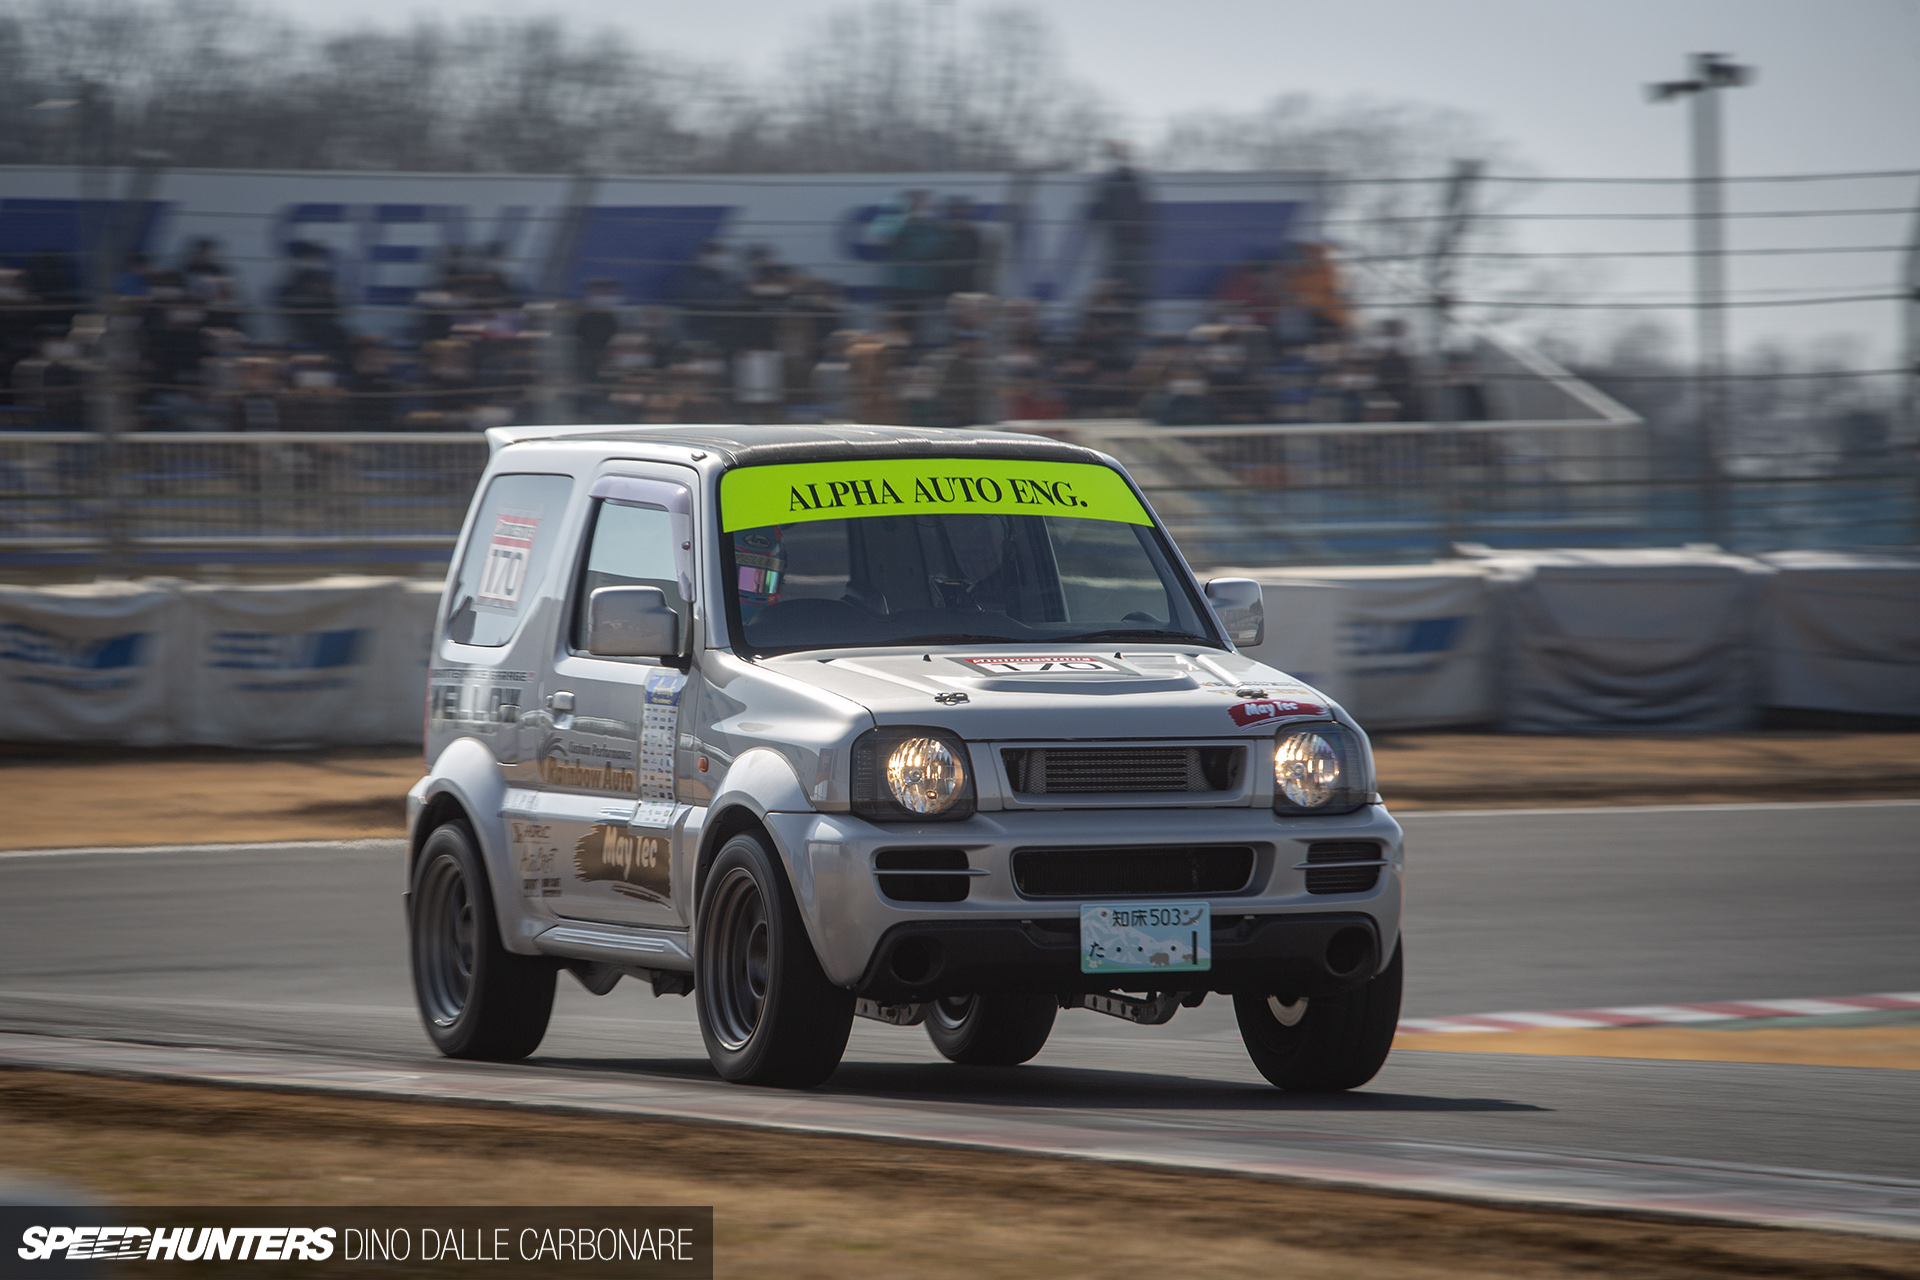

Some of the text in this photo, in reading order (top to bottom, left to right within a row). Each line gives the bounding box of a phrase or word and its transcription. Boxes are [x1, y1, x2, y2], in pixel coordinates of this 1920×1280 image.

[789, 476, 1088, 512] ALPHA AUTO ENG.
[485, 548, 524, 597] 170
[991, 662, 1104, 672] 170
[592, 743, 632, 760] Performance
[547, 755, 633, 792] Rainbow Auto
